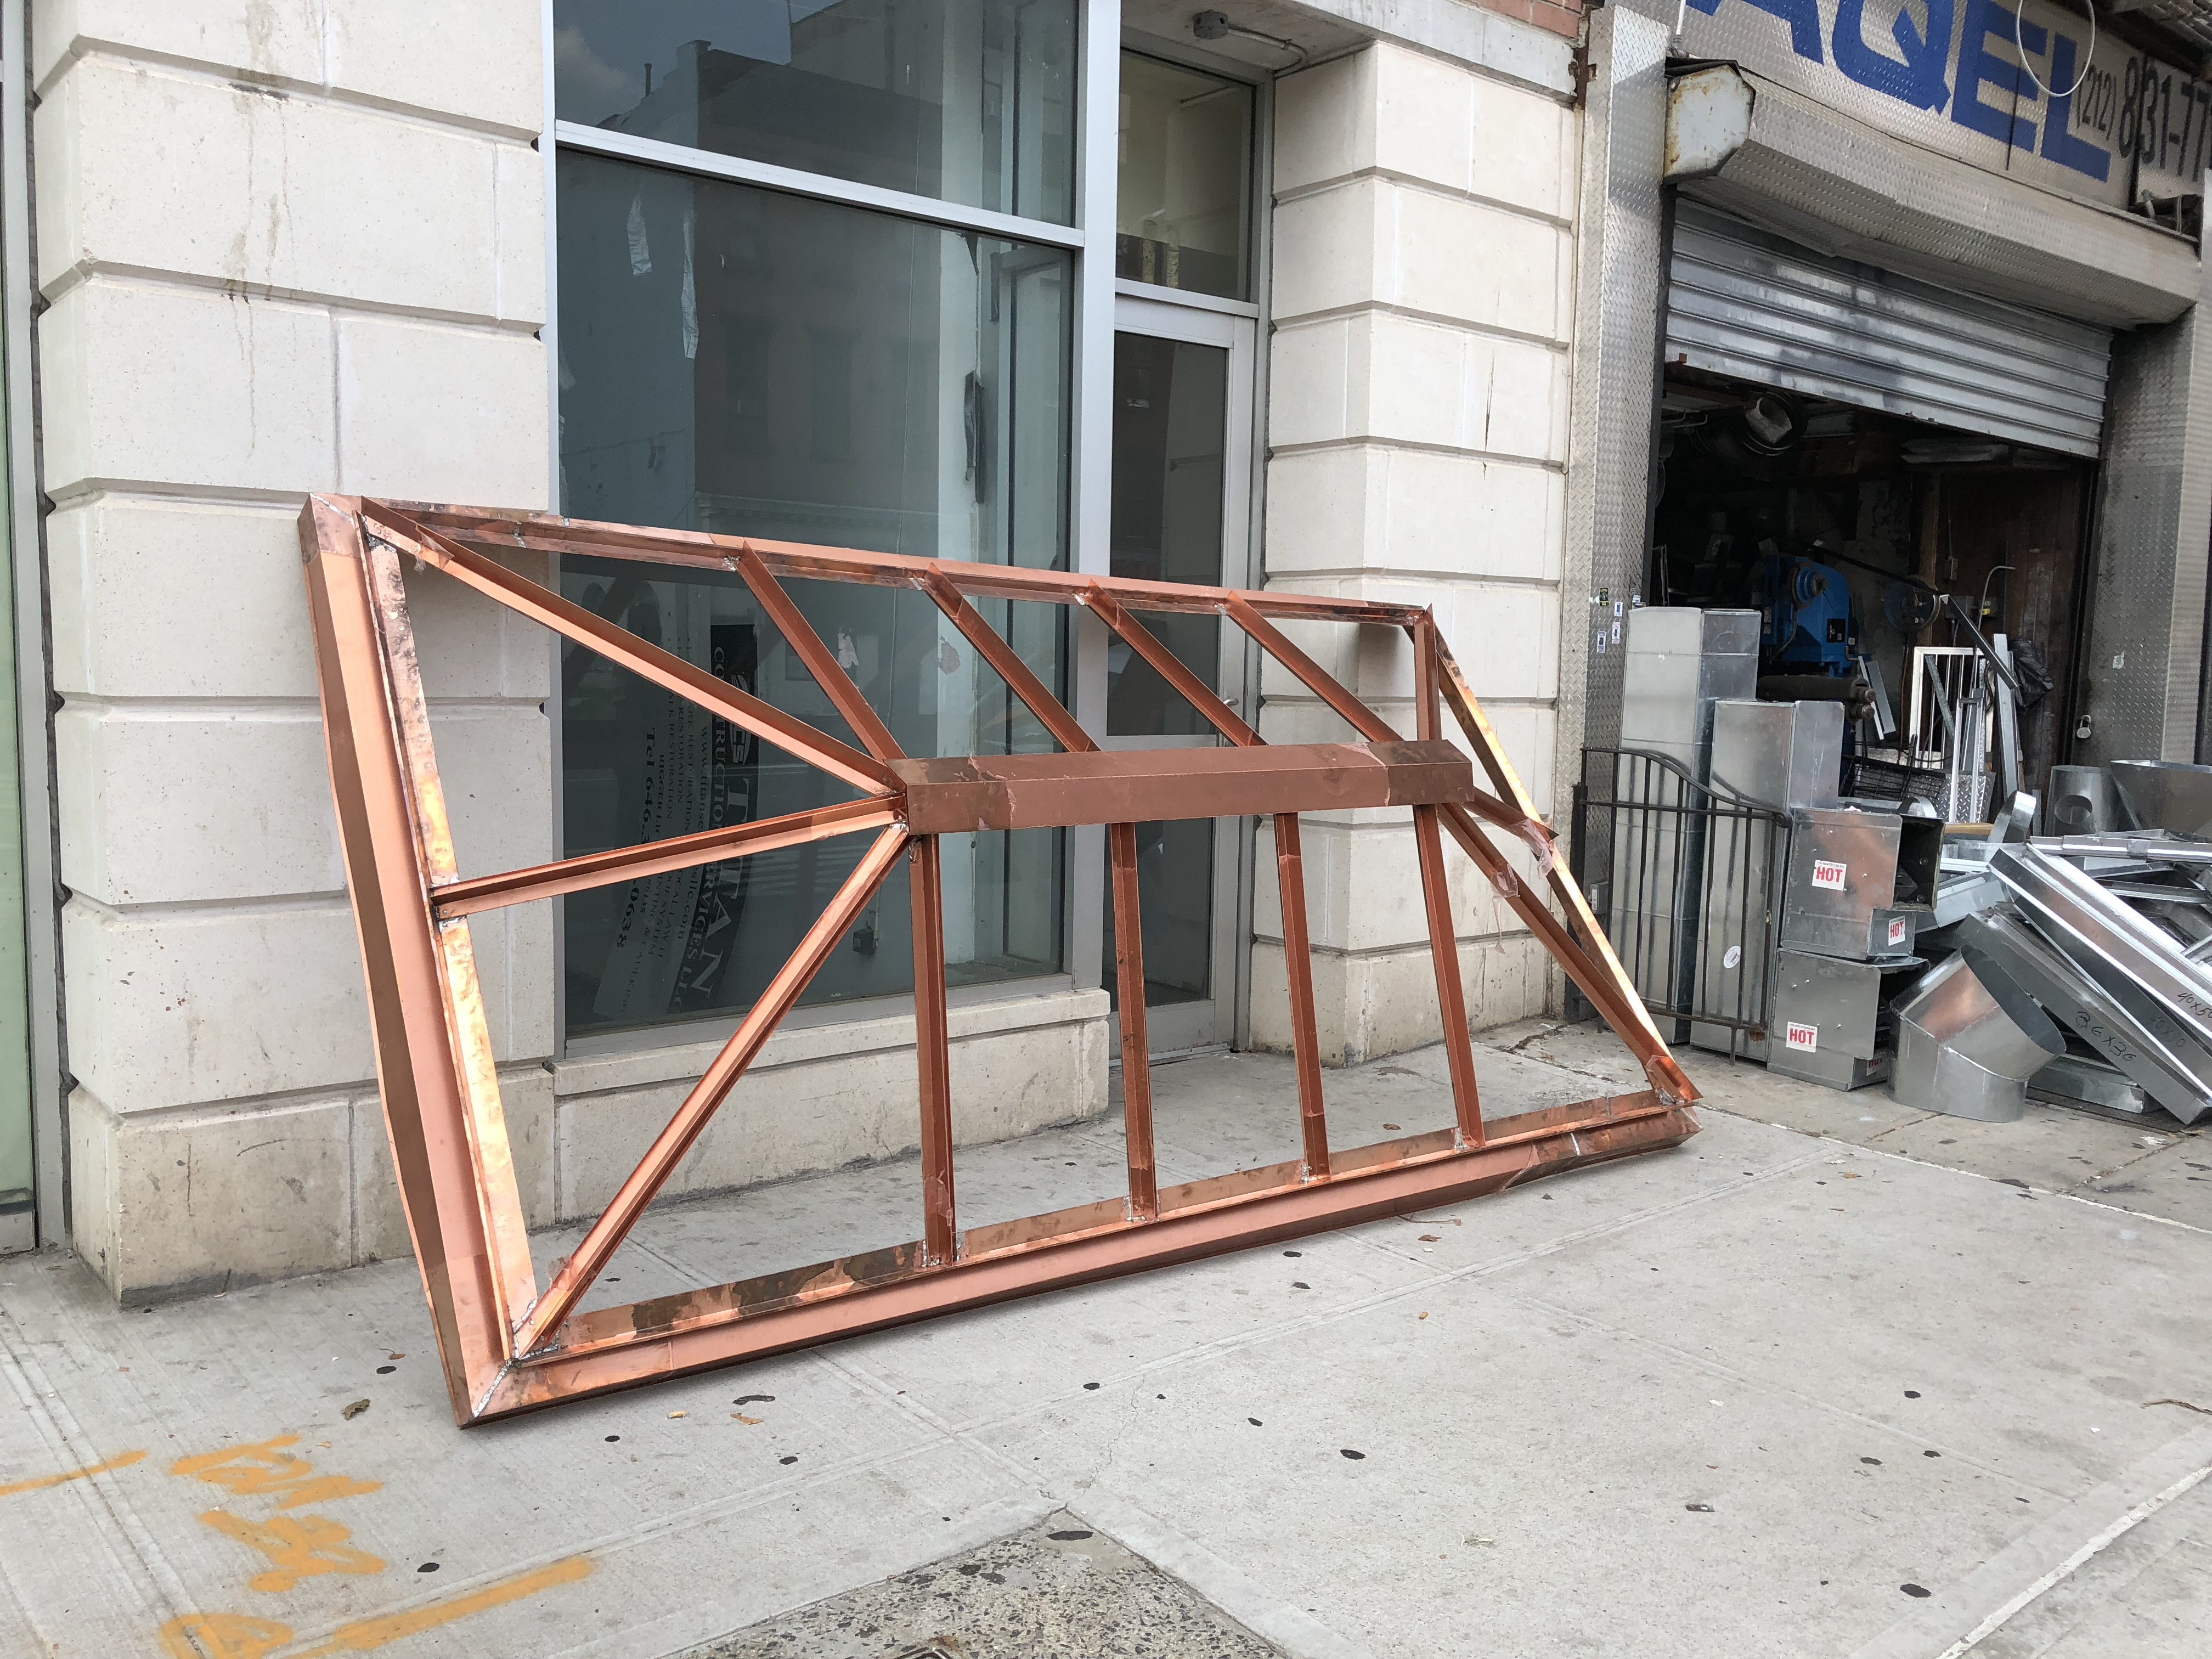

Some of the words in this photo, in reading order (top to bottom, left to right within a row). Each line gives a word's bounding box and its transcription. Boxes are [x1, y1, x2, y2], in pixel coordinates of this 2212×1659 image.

[2076, 61, 2118, 141] (212)
[2119, 56, 2212, 182] 831-77
[646, 727, 655, 766] Tel
[713, 647, 726, 829] COTRUCTIO
[657, 754, 665, 810] RIGGER
[667, 724, 675, 819] RESTORATION
[685, 735, 694, 831] RESTORATION
[647, 873, 663, 923] INTING
[664, 871, 676, 894] OOF
[672, 869, 684, 905] OCAL
[691, 778, 750, 999] TTAN
[1816, 866, 1843, 883] HOT
[647, 900, 668, 956] SYSTEM
[663, 911, 675, 942] LAW
[687, 862, 718, 961] ERVICES
[1890, 921, 1904, 939] HOT
[1789, 1028, 1815, 1045] HOT
